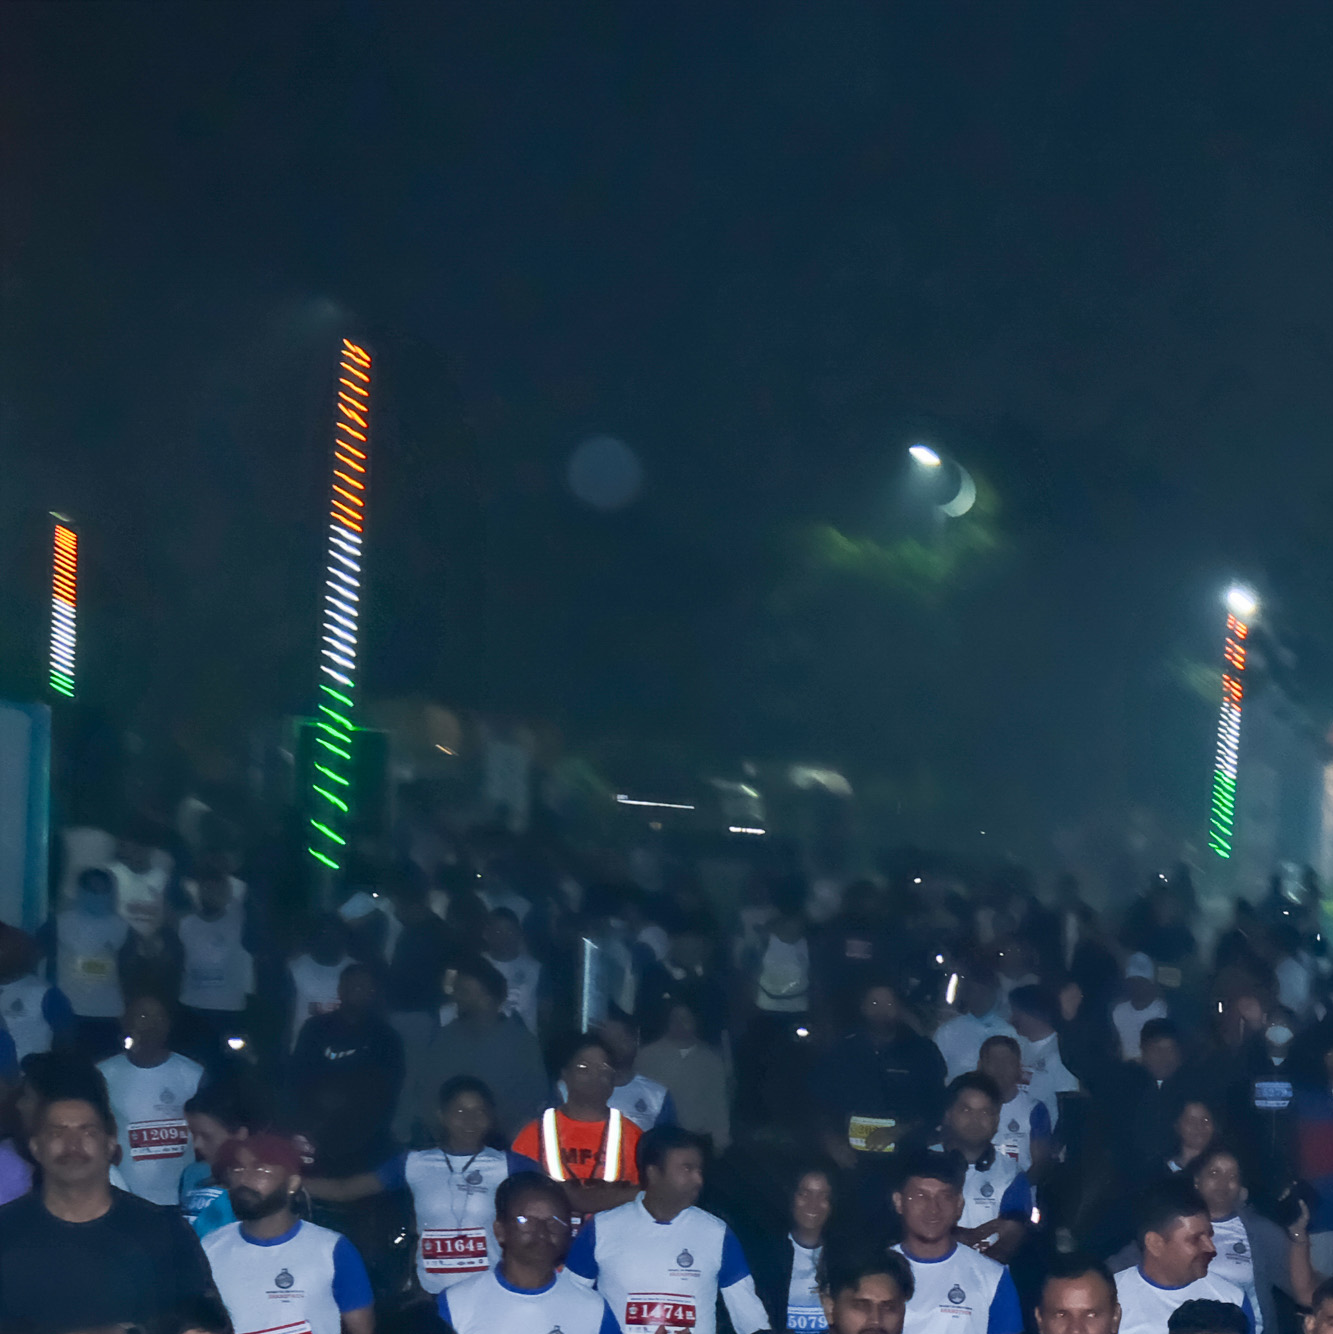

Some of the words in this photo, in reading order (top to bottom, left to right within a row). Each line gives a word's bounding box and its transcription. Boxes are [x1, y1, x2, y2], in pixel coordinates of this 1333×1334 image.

[141, 1127, 179, 1142] 1209
[434, 1239, 475, 1253] 1164
[640, 1303, 684, 1320] 1474
[787, 1315, 828, 1329] 5079
